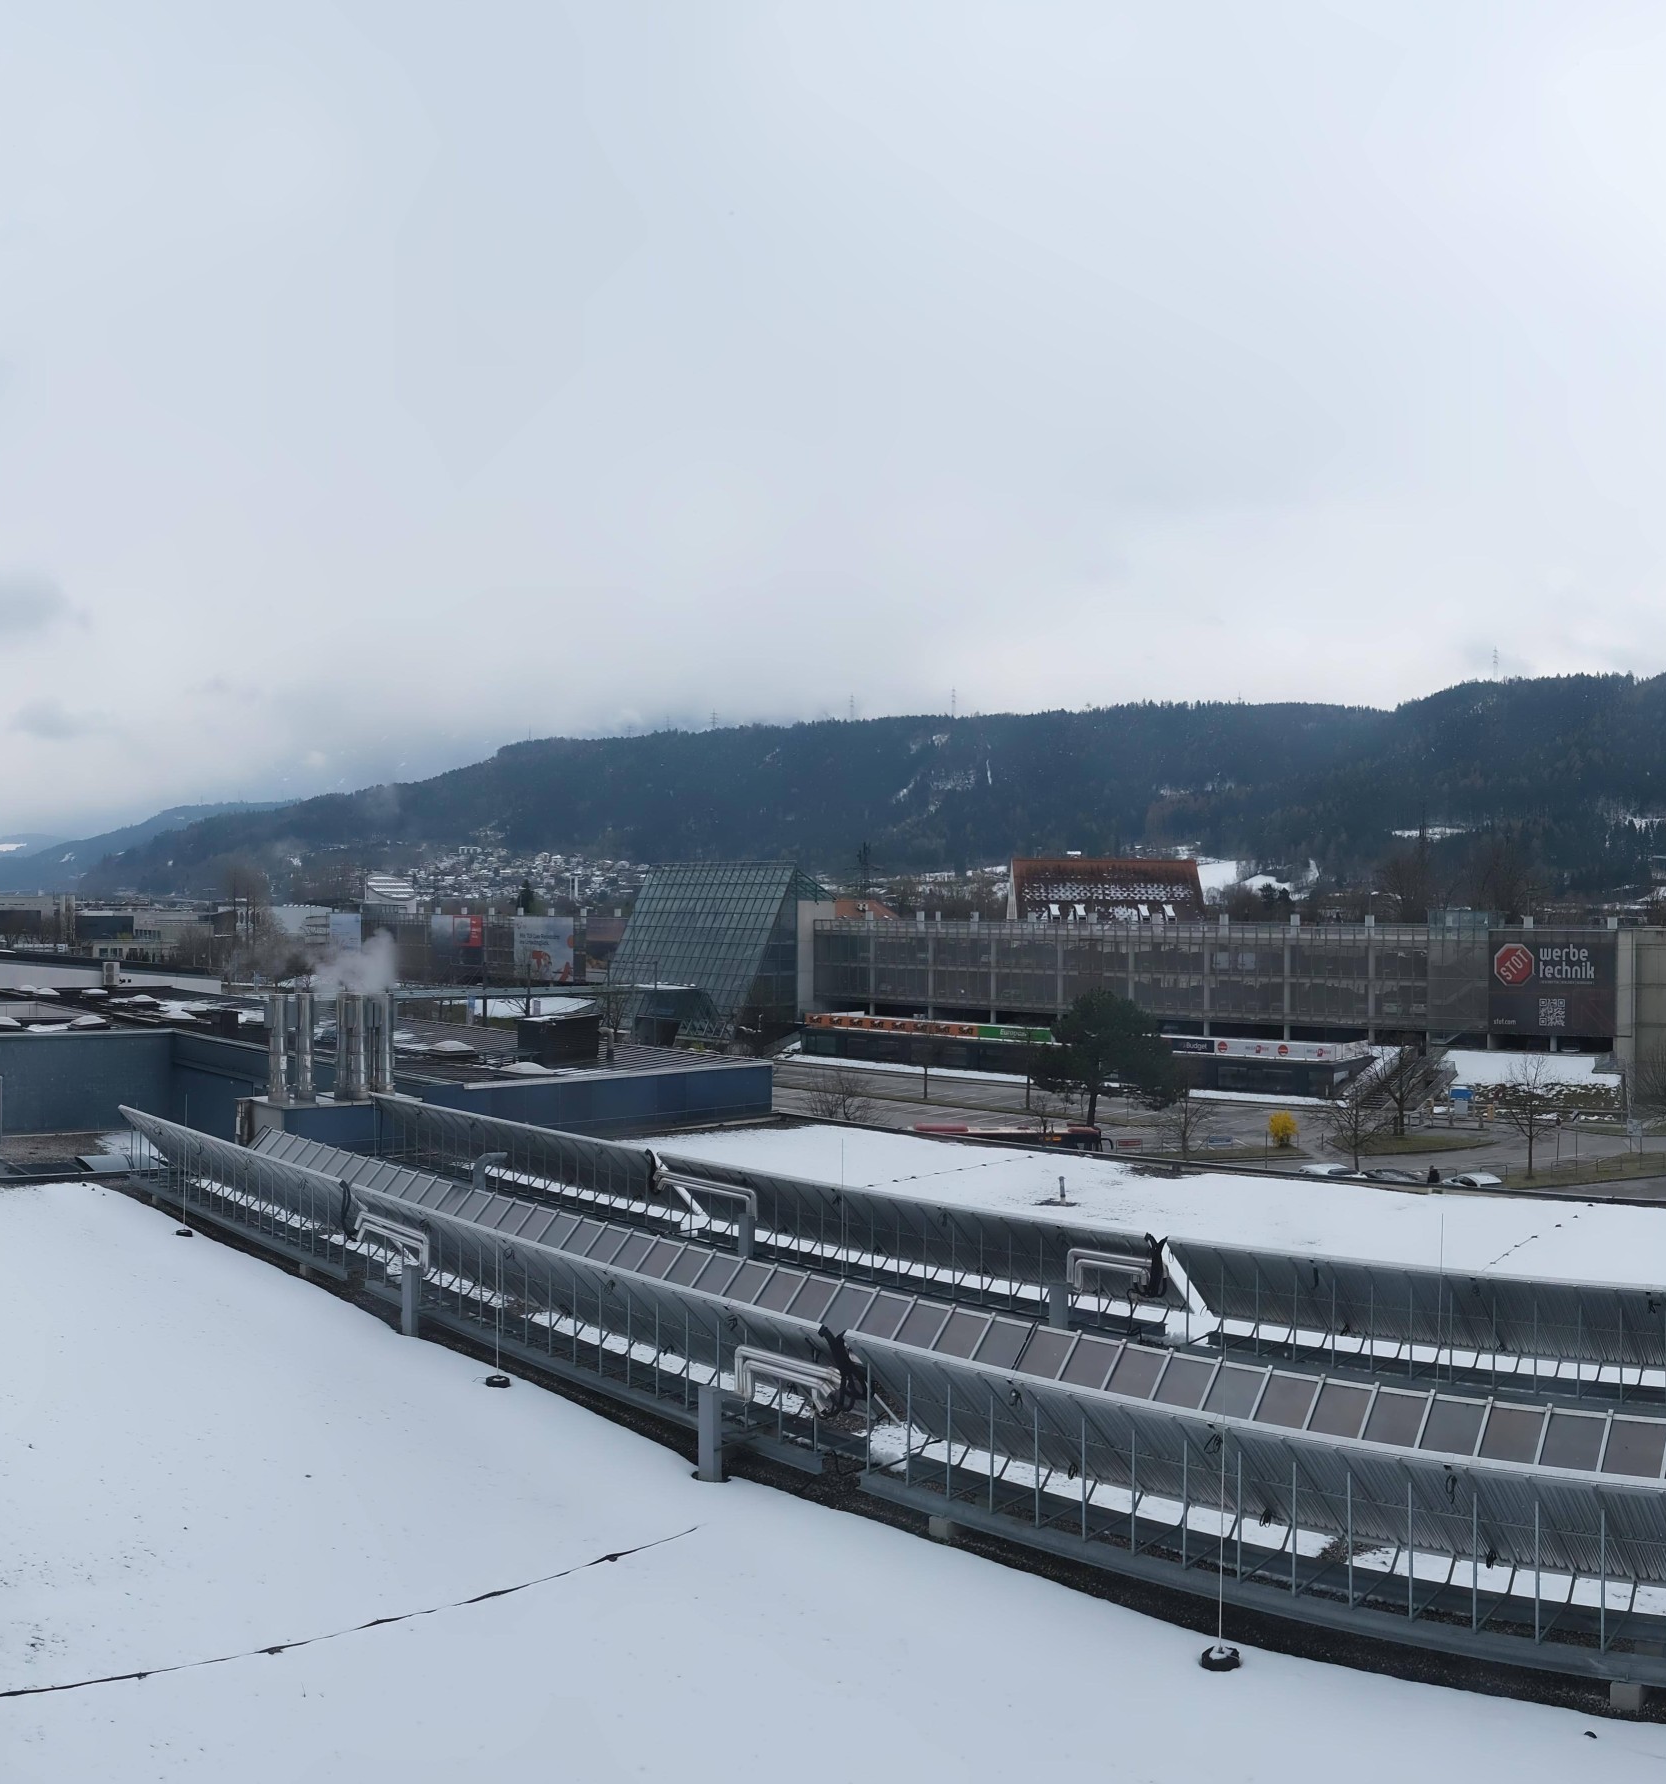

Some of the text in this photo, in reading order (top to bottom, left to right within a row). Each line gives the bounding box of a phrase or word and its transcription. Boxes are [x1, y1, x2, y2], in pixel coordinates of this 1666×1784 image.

[1539, 944, 1588, 961] werbe
[1500, 949, 1528, 980] STOT
[1539, 962, 1595, 979] technik
[1186, 1041, 1208, 1051] Budget
